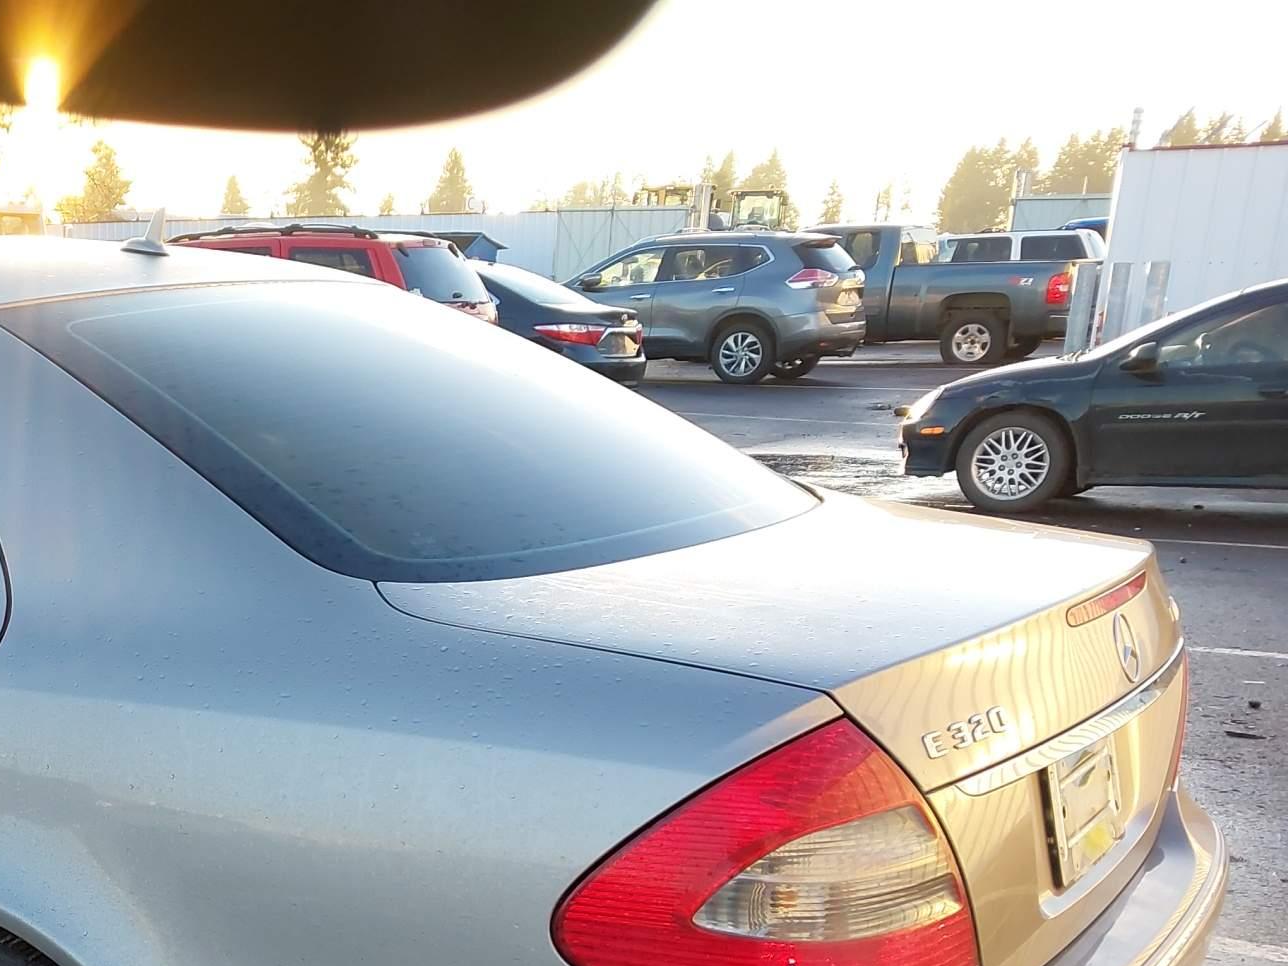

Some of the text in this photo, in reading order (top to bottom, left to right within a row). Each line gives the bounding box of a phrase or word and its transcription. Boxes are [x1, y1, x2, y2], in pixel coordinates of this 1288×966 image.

[1173, 411, 1207, 420] R/T
[921, 705, 1008, 760] E 320
